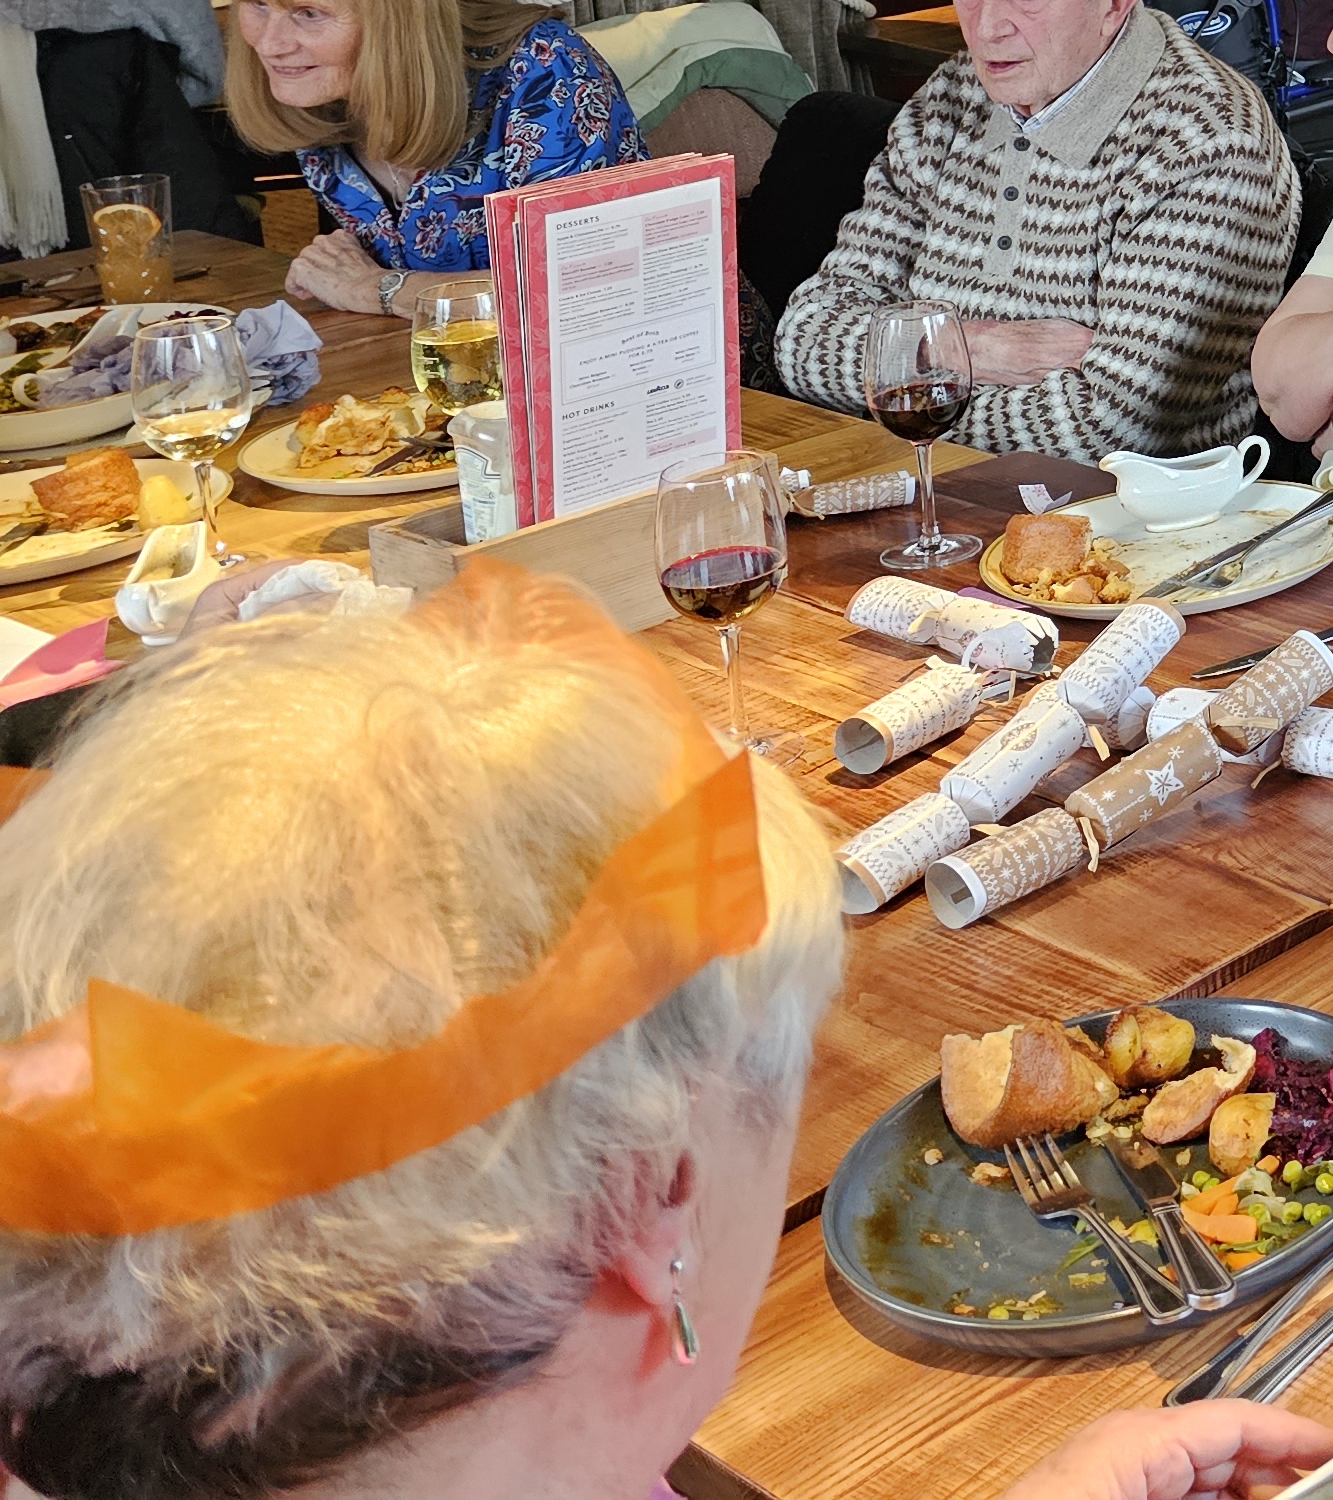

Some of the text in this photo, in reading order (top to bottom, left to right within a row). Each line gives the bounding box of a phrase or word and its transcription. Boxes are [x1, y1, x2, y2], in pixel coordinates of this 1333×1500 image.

[556, 215, 599, 230] DESSERTS
[562, 400, 614, 420] HOT DRINKS
